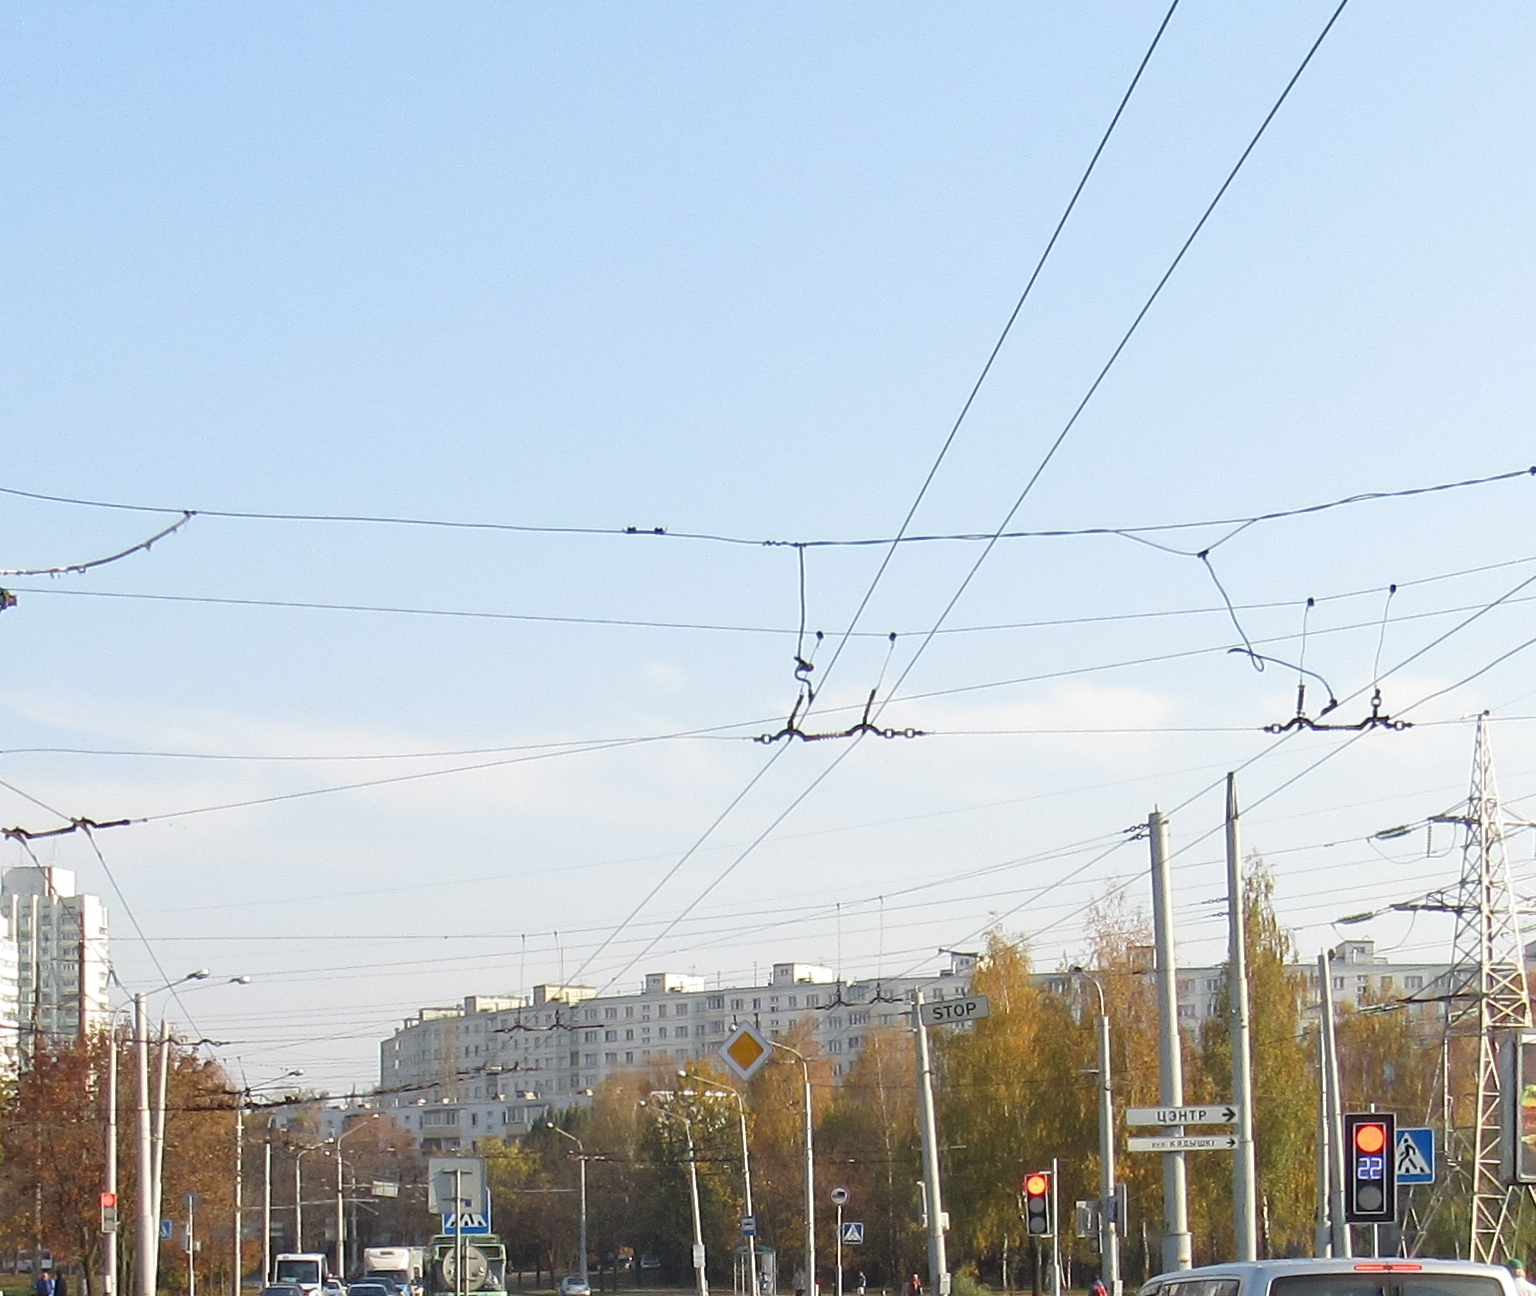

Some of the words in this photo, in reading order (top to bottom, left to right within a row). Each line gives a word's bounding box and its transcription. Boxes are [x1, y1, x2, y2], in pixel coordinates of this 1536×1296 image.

[932, 1002, 977, 1020] STOP
[1157, 1110, 1207, 1123] ЦЭНТР
[1357, 1157, 1382, 1180] 22
